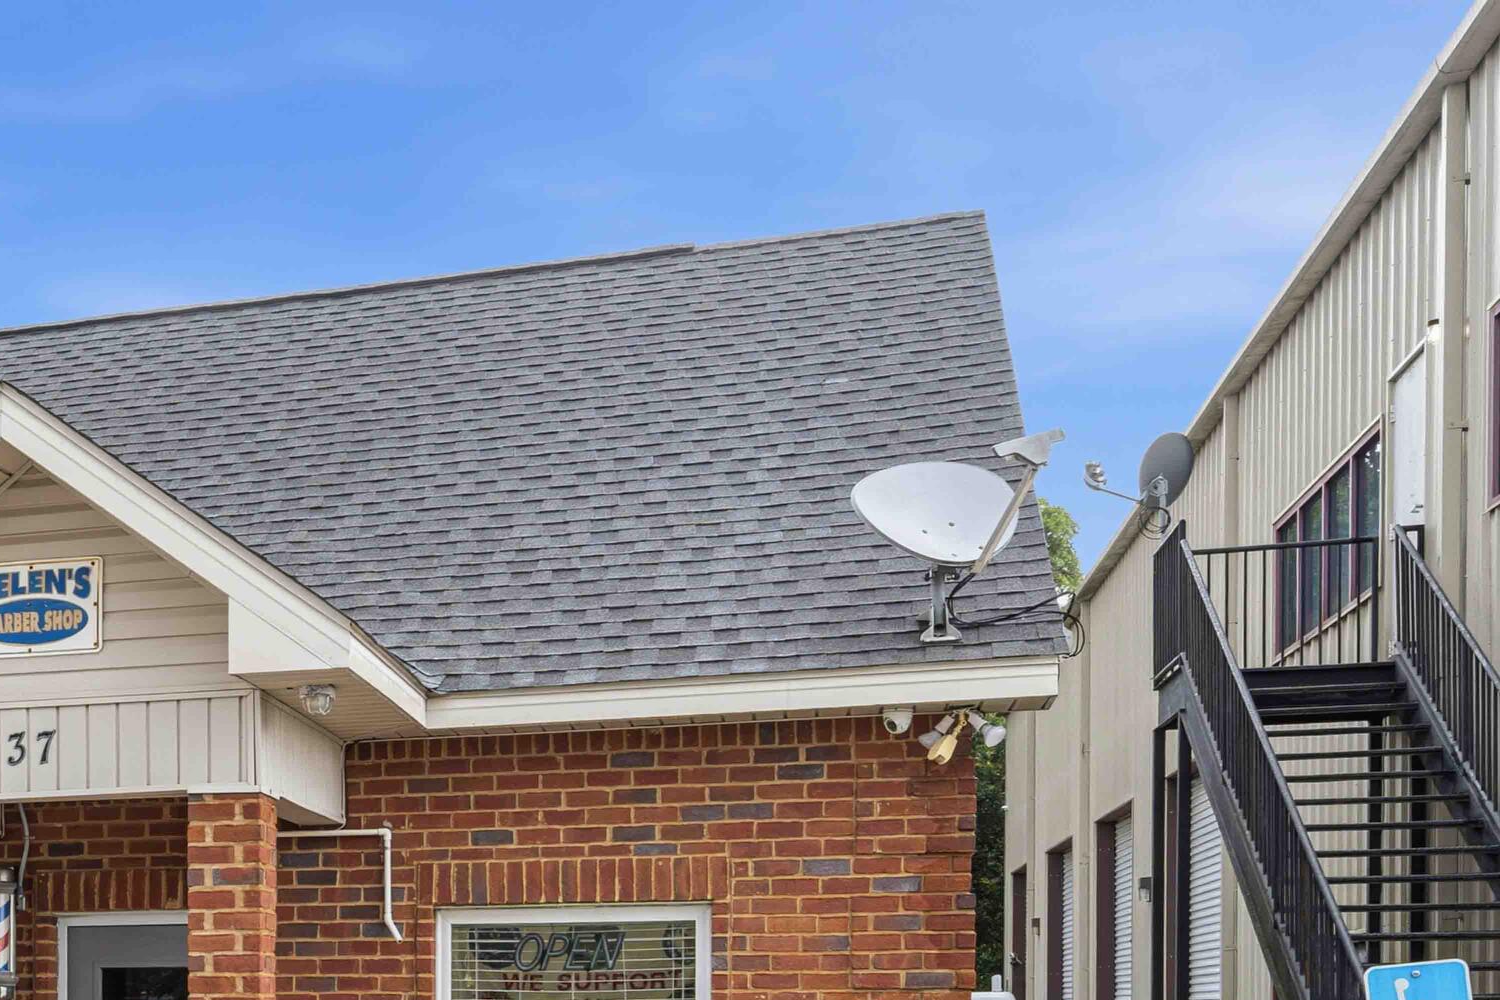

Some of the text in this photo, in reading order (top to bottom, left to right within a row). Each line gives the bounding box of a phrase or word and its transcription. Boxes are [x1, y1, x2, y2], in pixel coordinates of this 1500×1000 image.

[43, 609, 83, 631] SHOP
[513, 931, 627, 972] OPEN
[501, 969, 683, 991] WE SUPPORT
